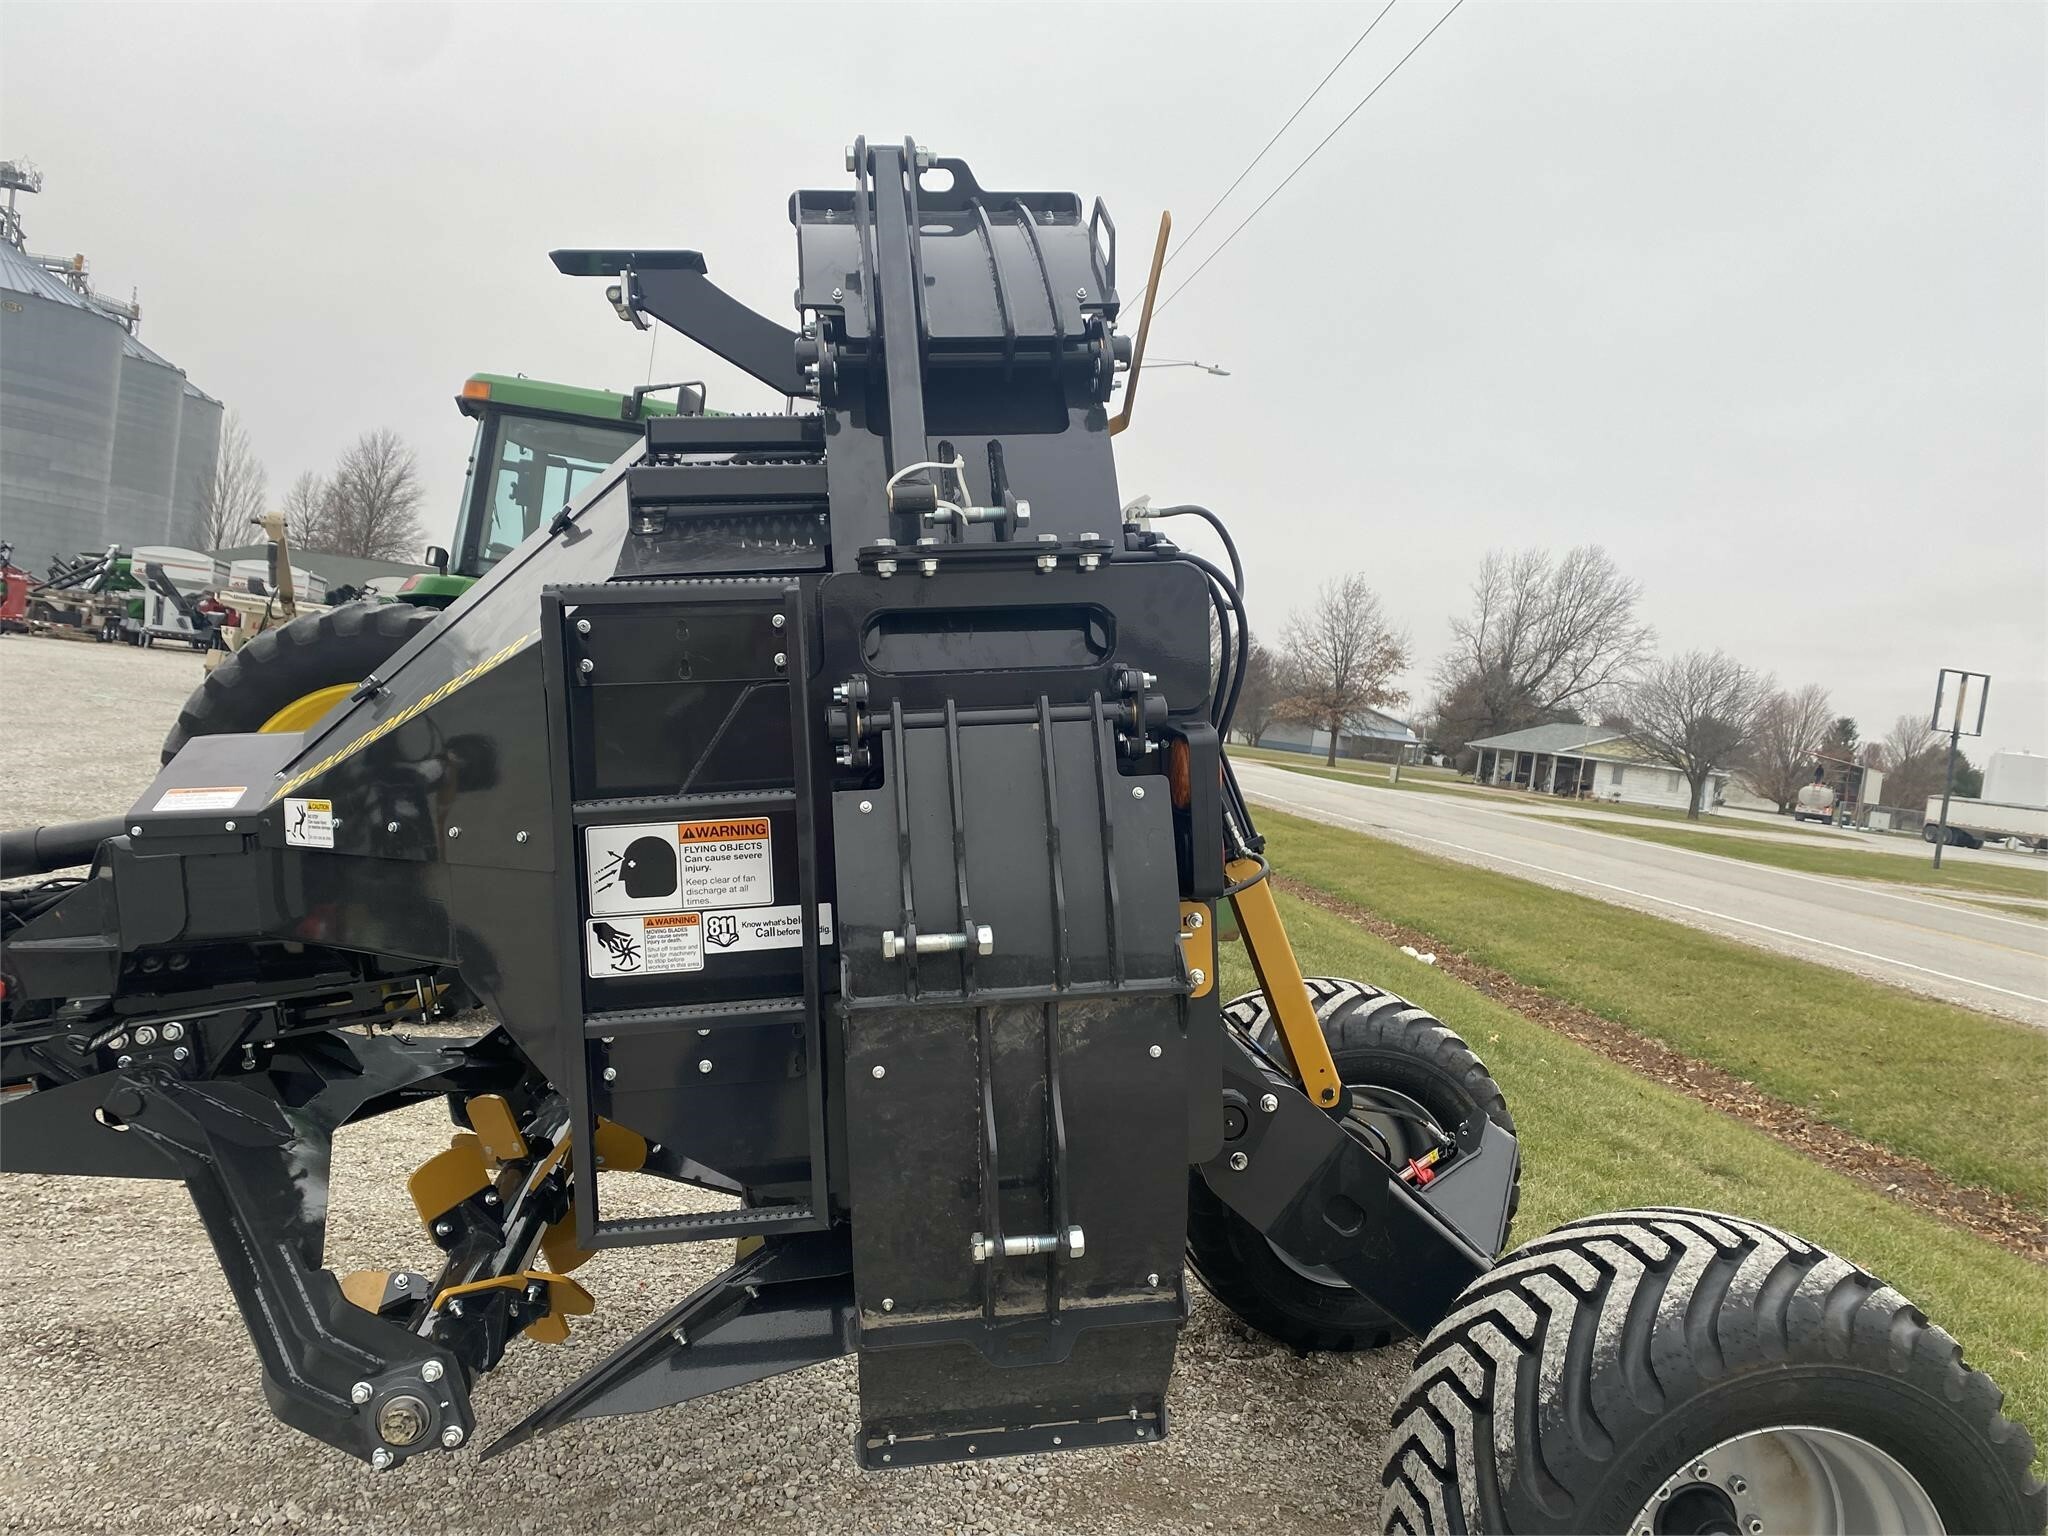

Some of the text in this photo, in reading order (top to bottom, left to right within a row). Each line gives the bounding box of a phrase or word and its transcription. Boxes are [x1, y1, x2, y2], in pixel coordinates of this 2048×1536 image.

[271, 635, 528, 801] REVOLUTION DITCHER
[695, 824, 766, 838] WARNING
[684, 842, 762, 853] FLYING OBJECTS
[684, 855, 703, 863] Can
[705, 854, 731, 862] cause
[685, 865, 712, 873] injury.
[686, 878, 708, 887] Keep
[732, 875, 741, 883] of
[743, 874, 756, 882] fan
[686, 888, 727, 896] discharge
[687, 898, 712, 906] times.
[654, 916, 697, 926] WARNING
[707, 916, 736, 936] 811
[762, 919, 786, 927] what's
[786, 916, 802, 925] bel
[755, 927, 776, 938] Call
[776, 928, 801, 936] before
